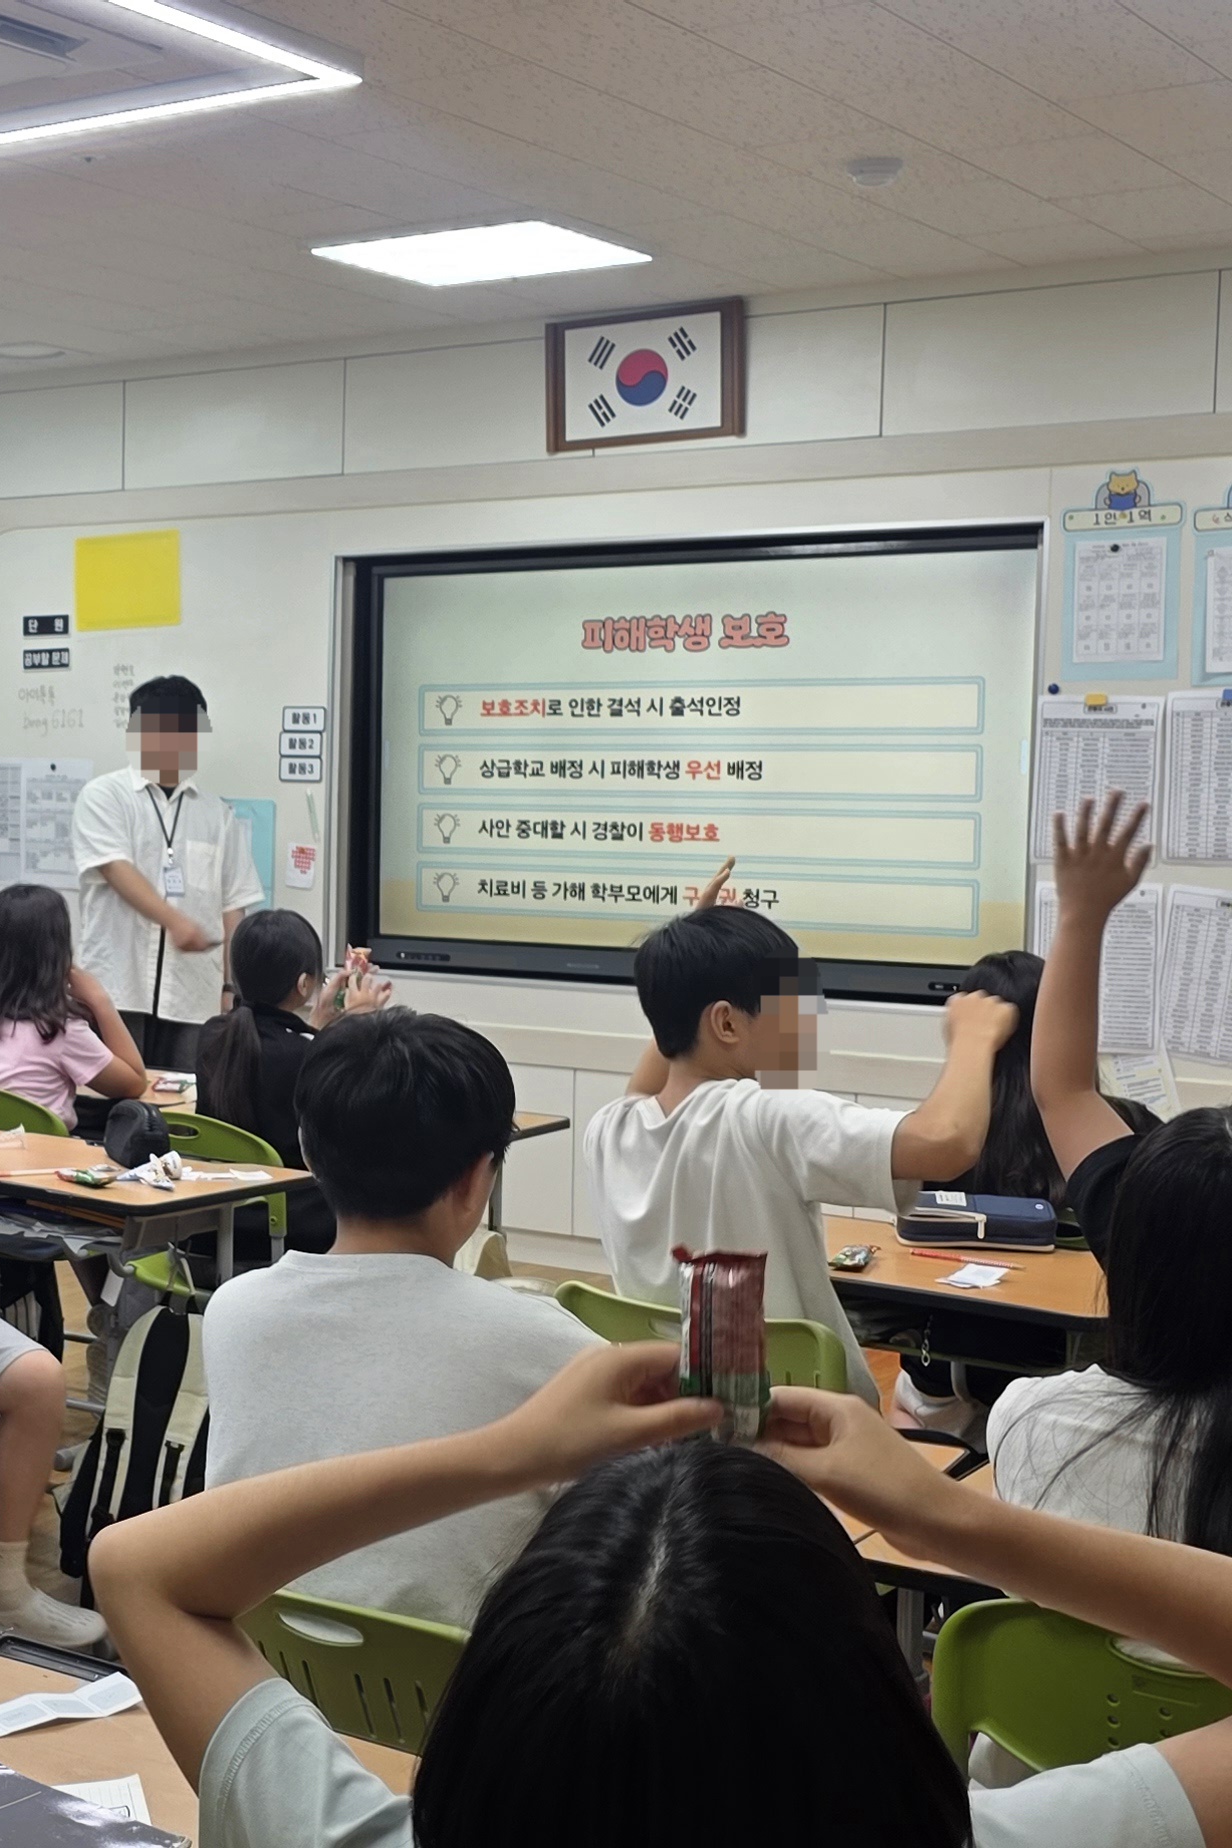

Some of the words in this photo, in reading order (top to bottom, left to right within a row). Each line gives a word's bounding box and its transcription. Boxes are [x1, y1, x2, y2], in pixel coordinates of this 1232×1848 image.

[581, 613, 712, 653] 피해학생
[718, 611, 790, 649] 보호
[480, 697, 563, 718] 보호조치로
[568, 697, 602, 717] 인한
[606, 697, 641, 717] 결석
[646, 697, 664, 717] 시
[669, 696, 741, 717] 출석인정
[479, 759, 545, 779] 상급학교
[550, 759, 583, 779] 배정
[588, 759, 605, 779] 시
[610, 759, 680, 780] 피해학생
[685, 760, 721, 780] 우선
[727, 760, 763, 781] 배정
[478, 818, 511, 838] 사안
[515, 819, 566, 840] 중대할
[570, 820, 587, 840] 시
[591, 821, 643, 842] 경찰이
[648, 822, 721, 843] 동행보호
[477, 879, 527, 899] 치료비
[530, 881, 548, 900] 등
[552, 881, 586, 901] 가해
[591, 883, 678, 905] 학부모에게
[682, 886, 738, 907] 구권
[742, 887, 780, 909] 청구
